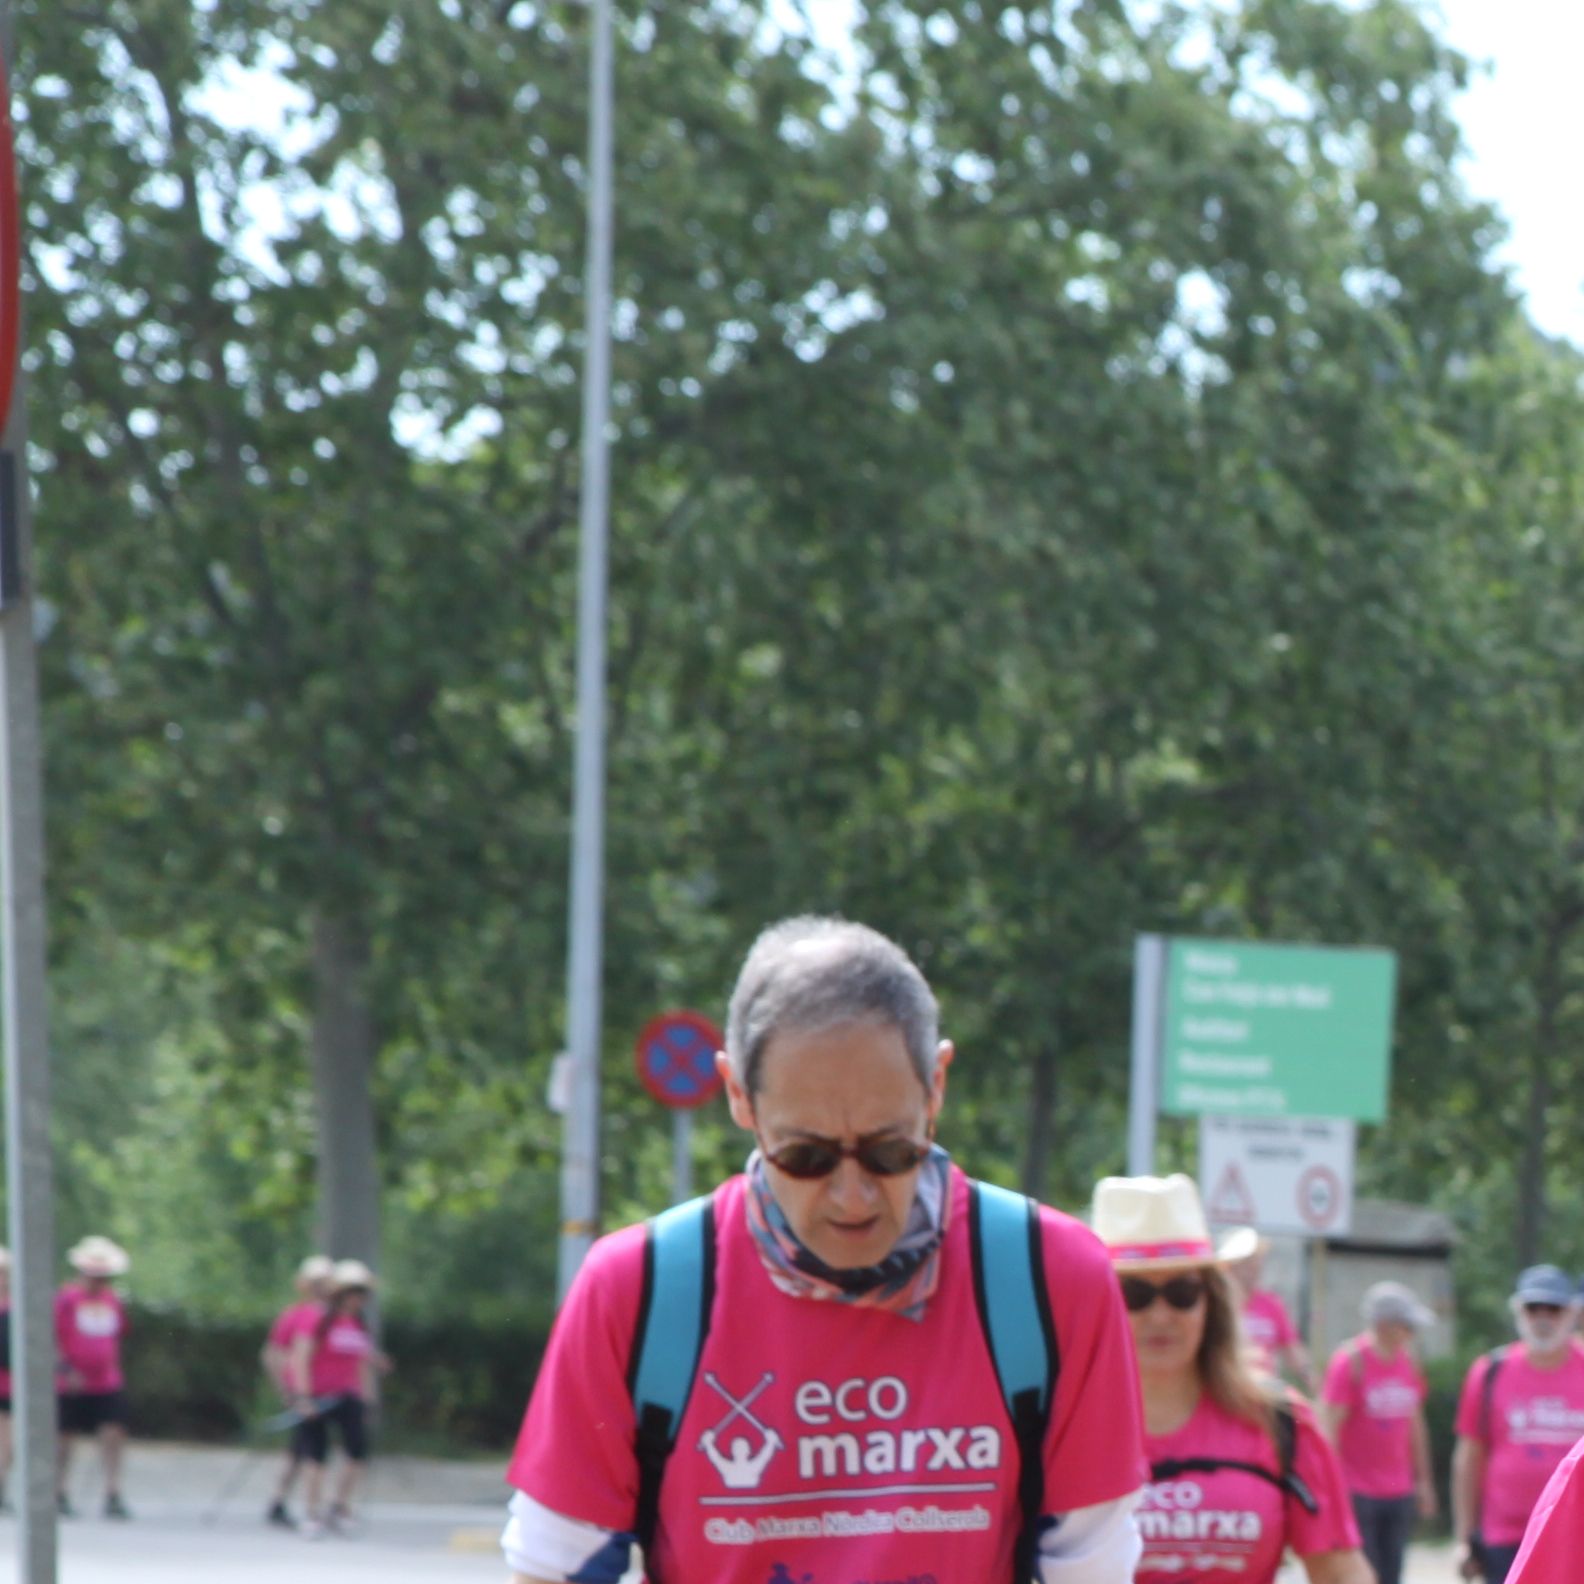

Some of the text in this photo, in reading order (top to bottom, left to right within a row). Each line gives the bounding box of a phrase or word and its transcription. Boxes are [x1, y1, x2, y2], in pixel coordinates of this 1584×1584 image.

[795, 1376, 908, 1424] eco
[798, 1425, 1001, 1479] marxa
[705, 1517, 755, 1545] Club
